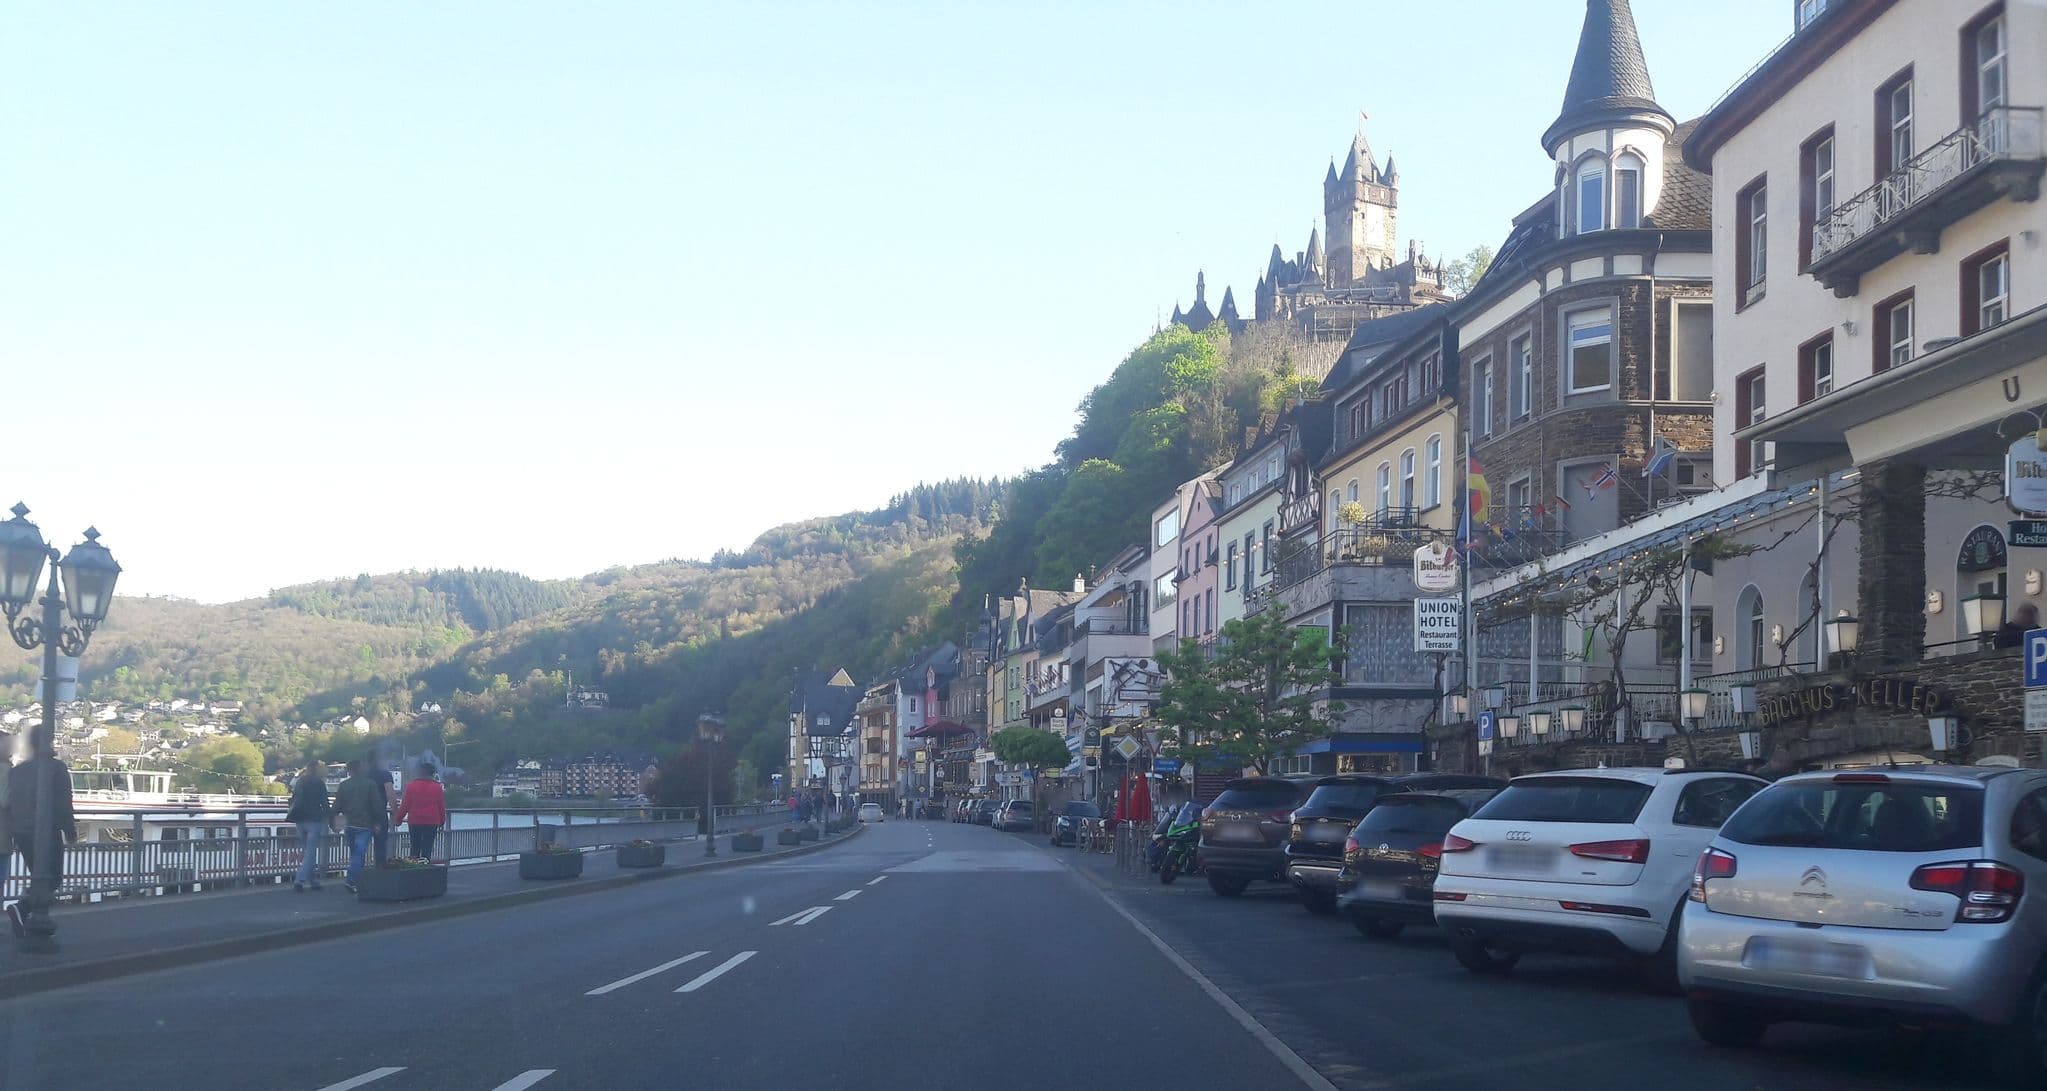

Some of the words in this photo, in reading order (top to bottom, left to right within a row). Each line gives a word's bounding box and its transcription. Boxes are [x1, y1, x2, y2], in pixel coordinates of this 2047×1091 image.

[2003, 375, 2020, 402] U
[1420, 602, 1457, 614] UNION
[1420, 616, 1457, 627] HOTEL
[1420, 630, 1457, 640] Restaurant
[1424, 640, 1453, 649] Terrasse
[2031, 636, 2047, 680] P
[1482, 716, 1489, 737] P
